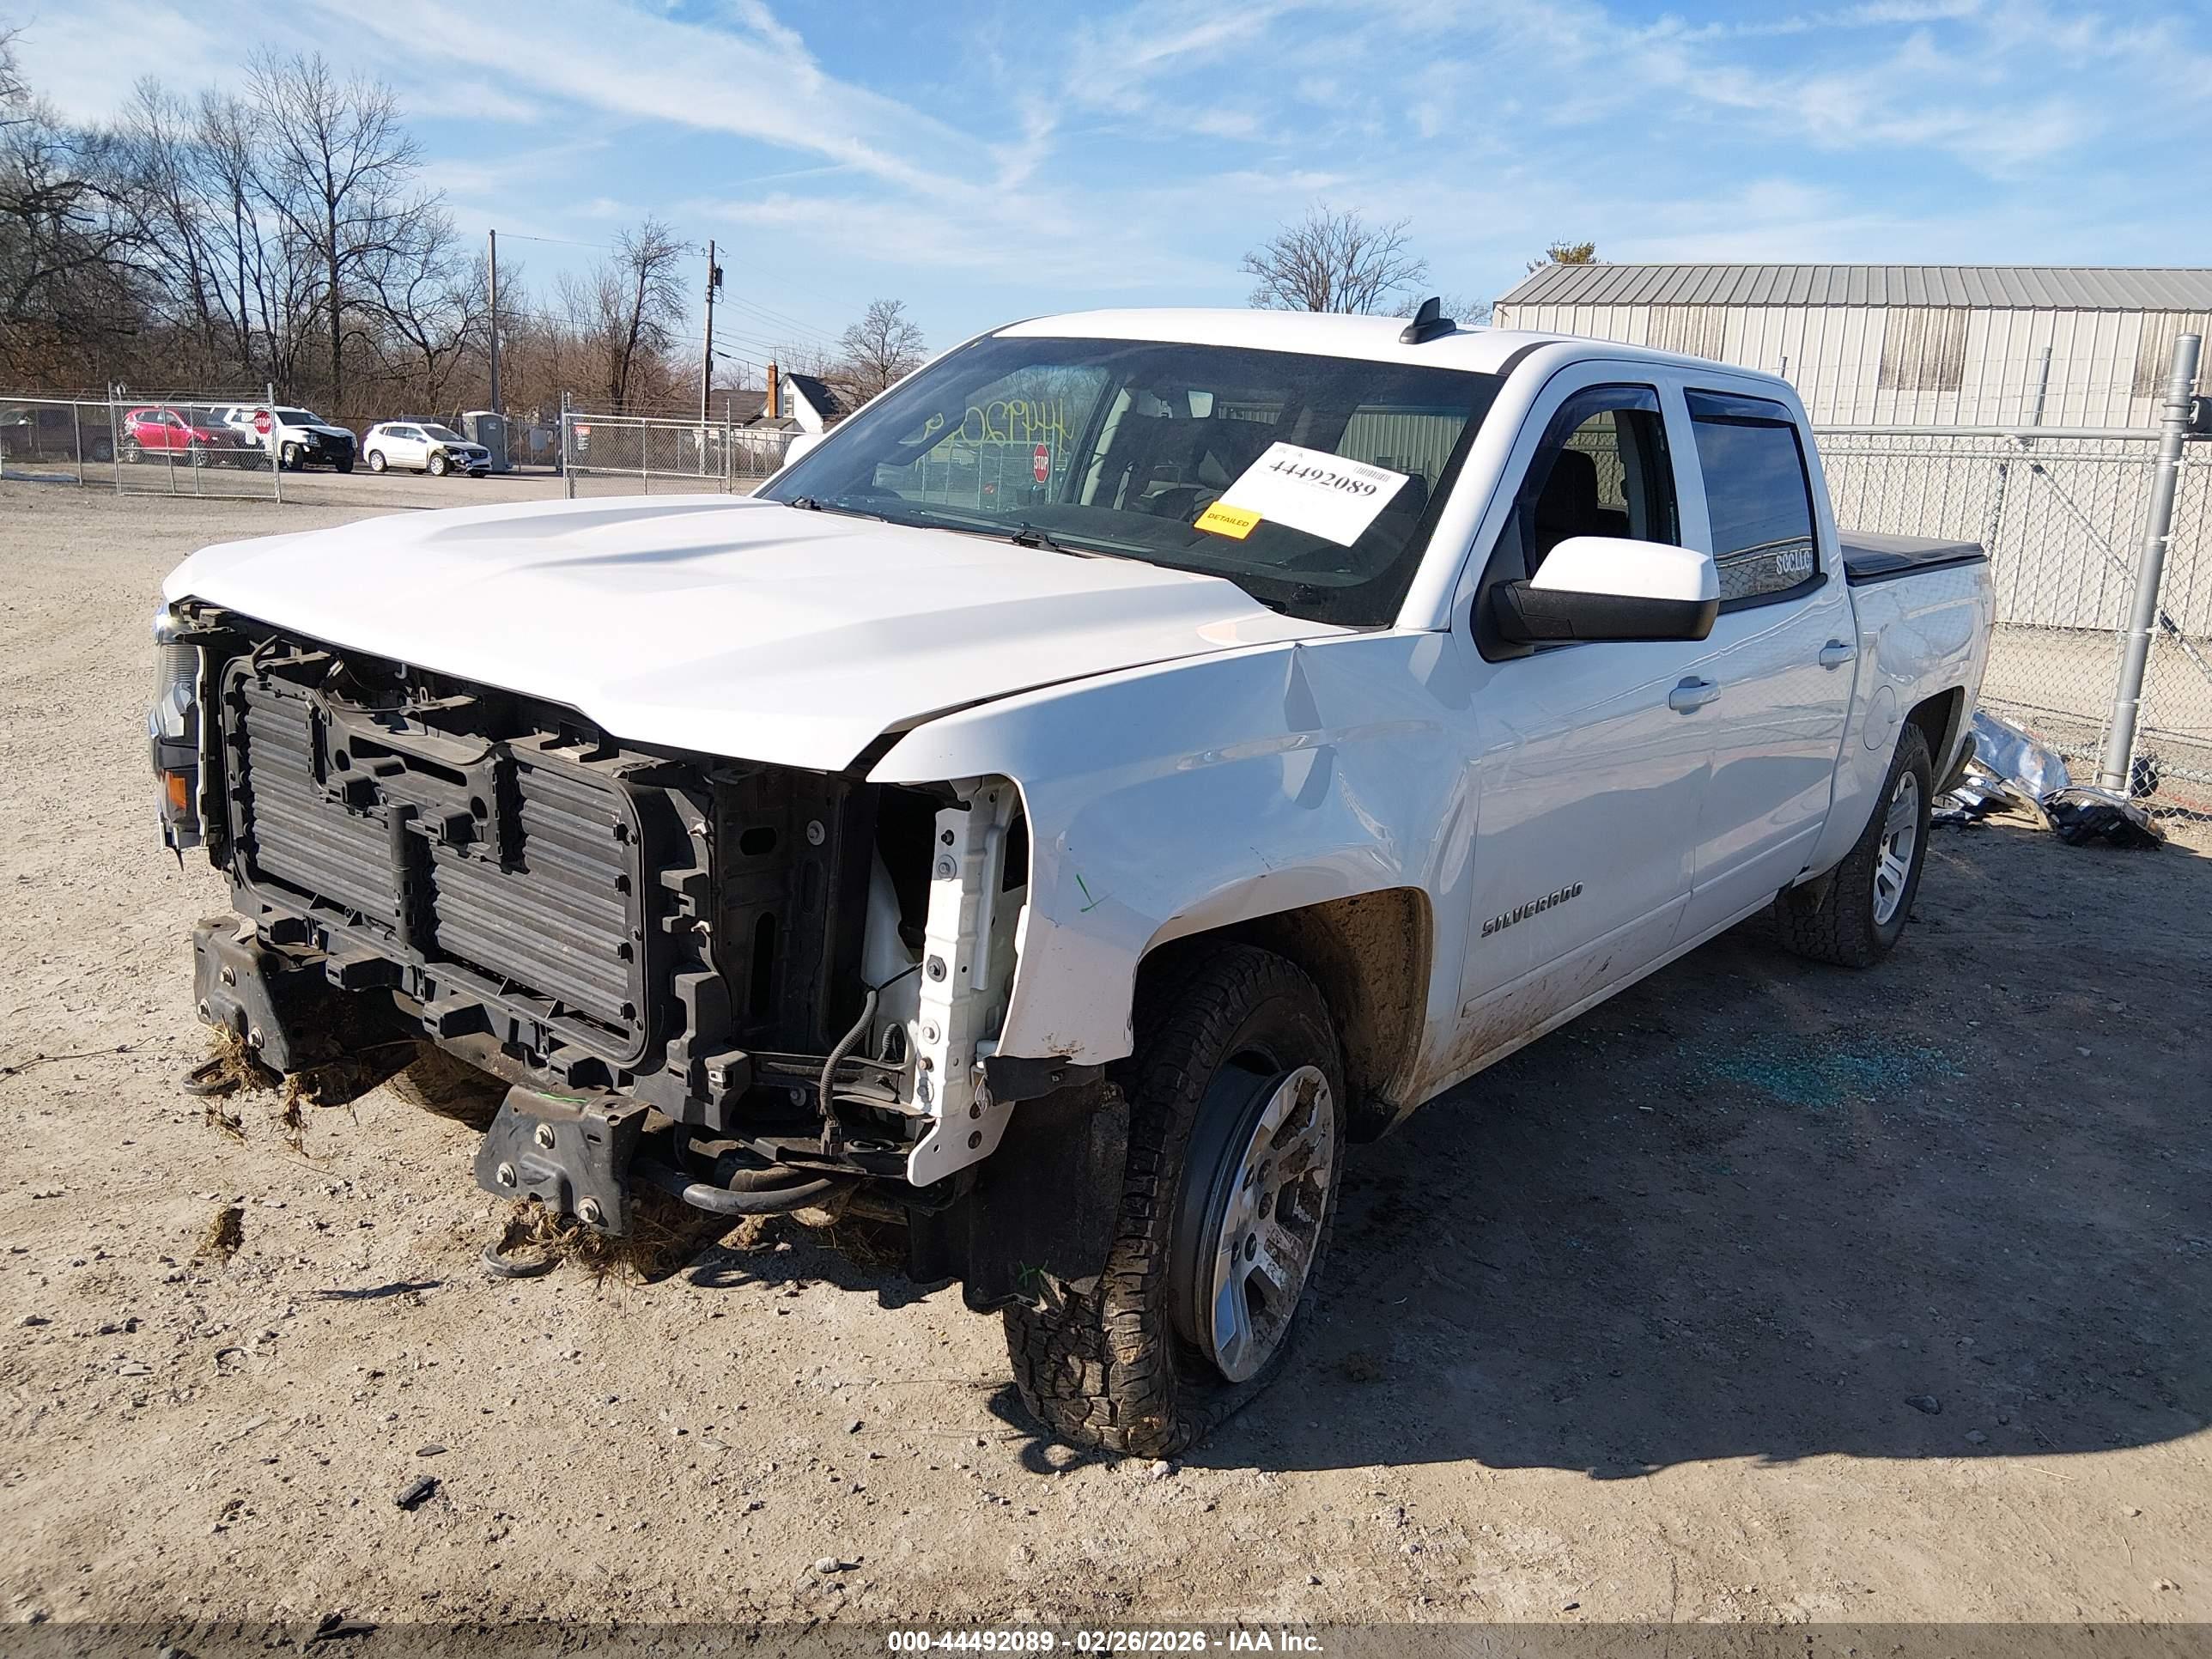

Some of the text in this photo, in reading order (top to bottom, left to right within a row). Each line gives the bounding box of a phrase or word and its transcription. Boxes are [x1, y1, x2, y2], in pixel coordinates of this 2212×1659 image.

[255, 417, 271, 428] STOP
[1034, 455, 1048, 471] STOP
[1268, 459, 1378, 497] 44492089
[1206, 513, 1249, 527] DETAILED
[1481, 880, 1584, 939] SILVERADO
